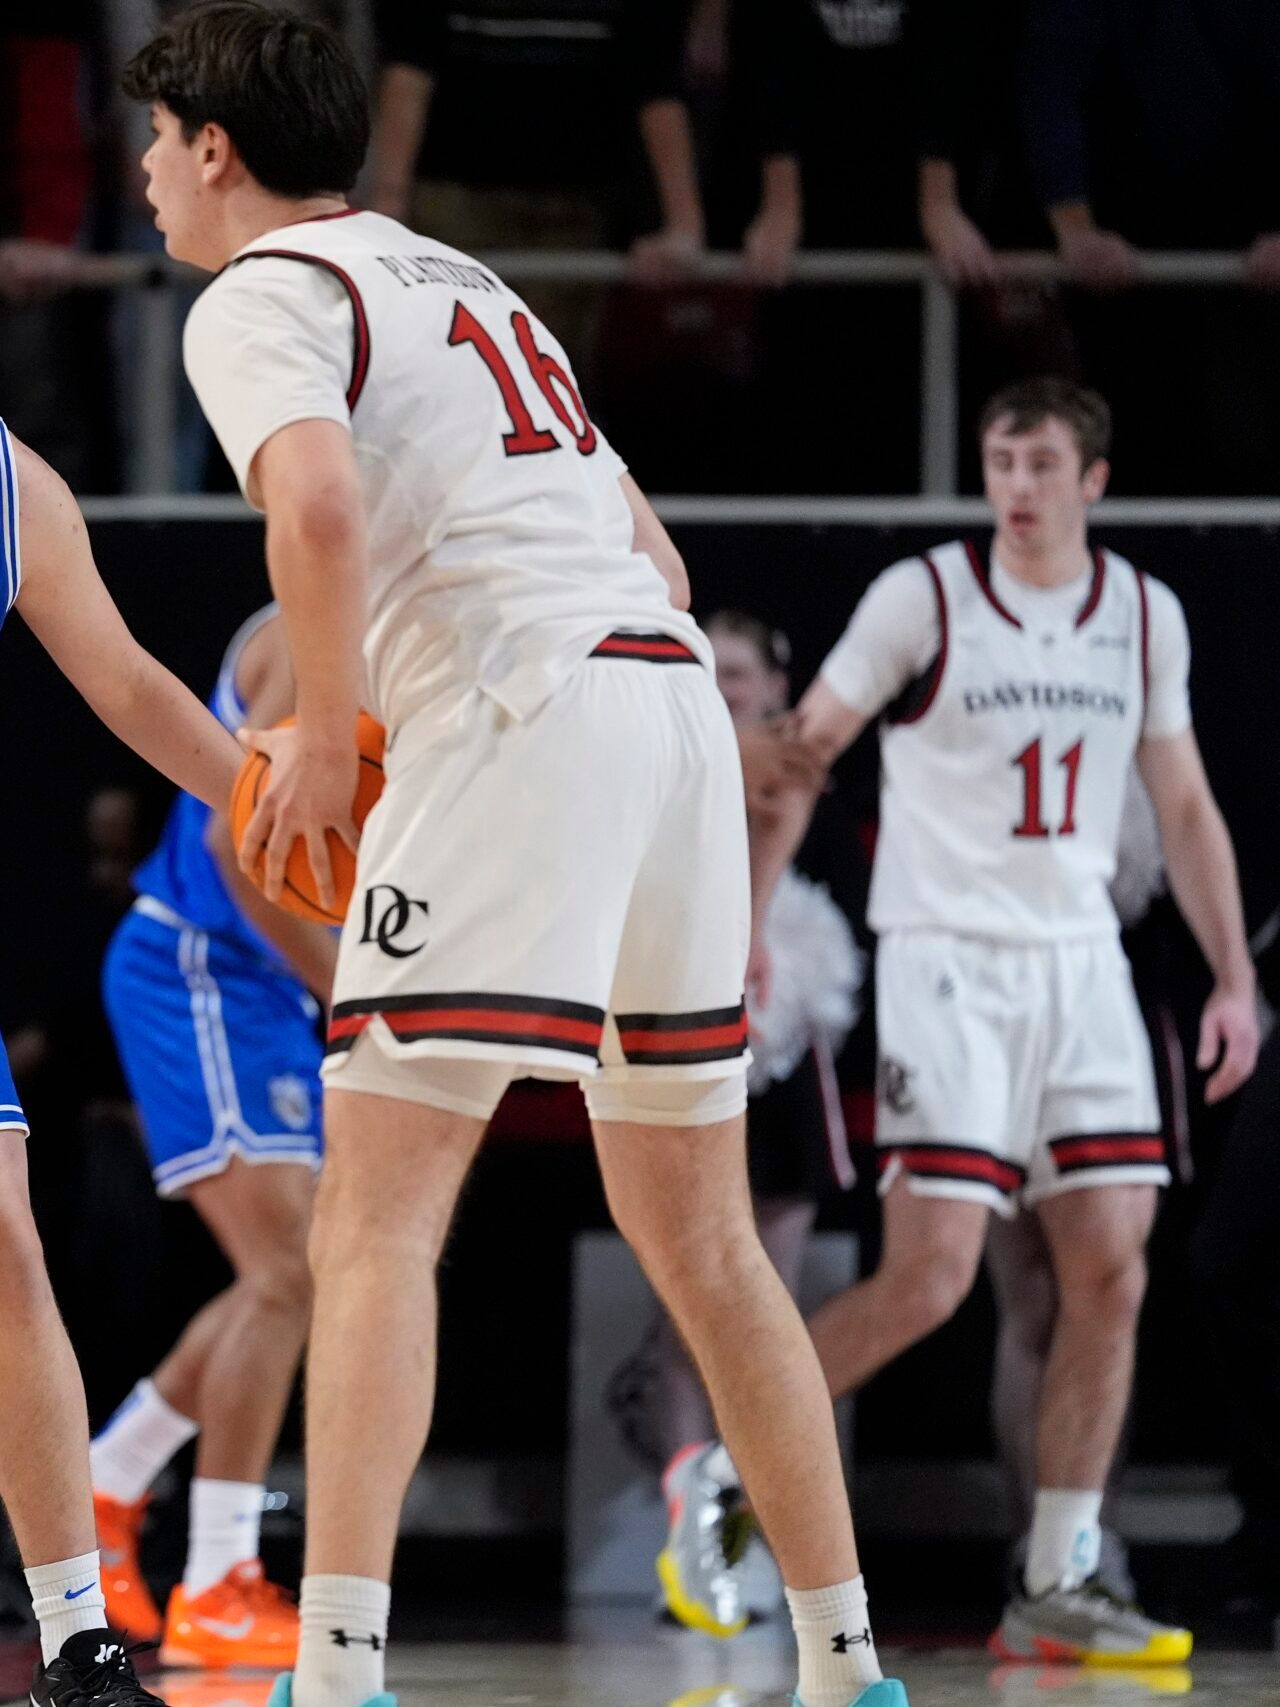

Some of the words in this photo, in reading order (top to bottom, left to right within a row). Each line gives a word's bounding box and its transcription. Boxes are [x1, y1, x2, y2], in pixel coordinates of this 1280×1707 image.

[447, 300, 597, 456] 16
[963, 681, 1127, 717] DAVIDSON
[1010, 735, 1084, 838] 11
[359, 884, 429, 959] DC
